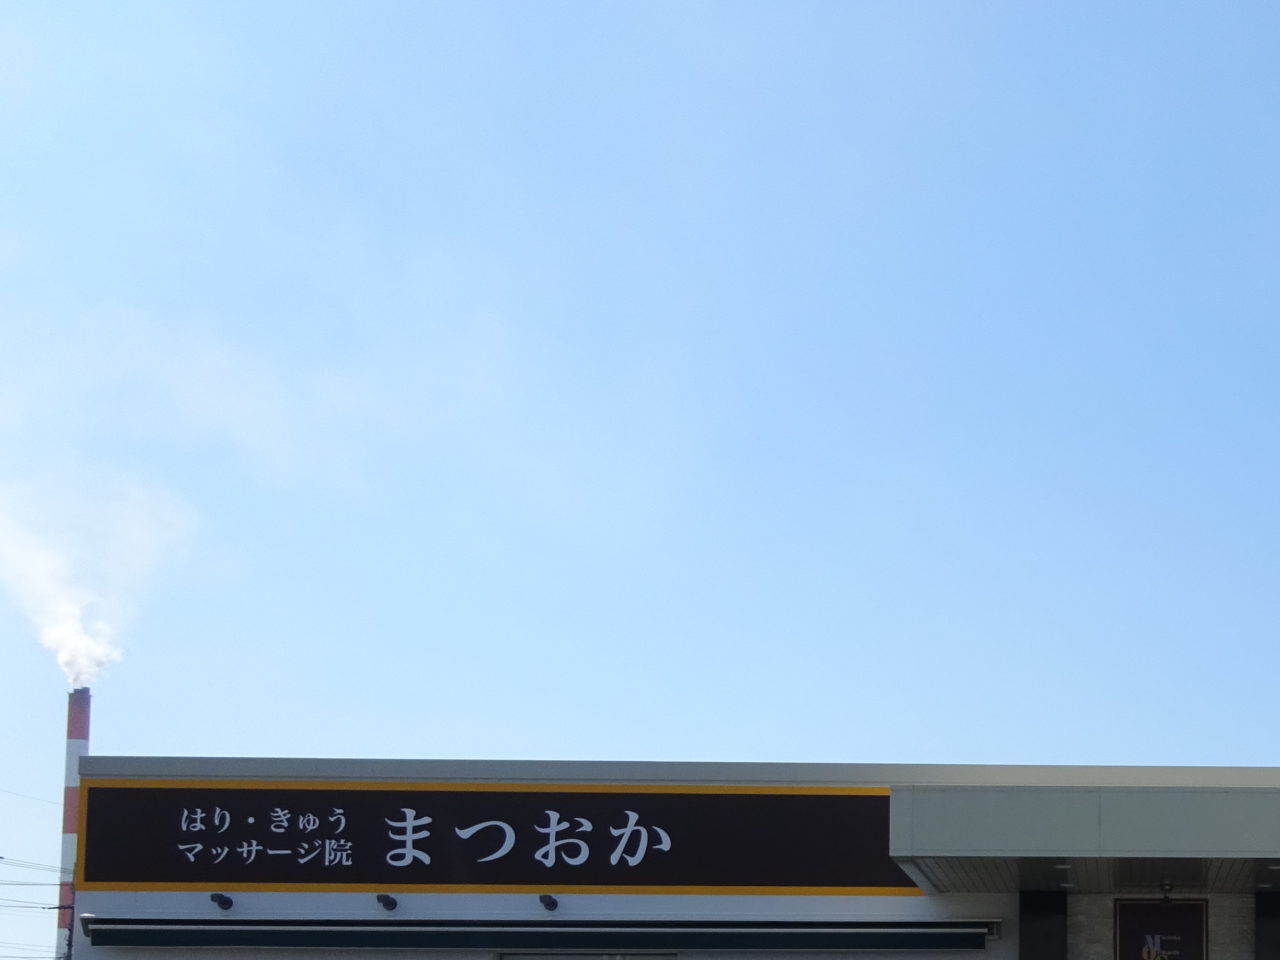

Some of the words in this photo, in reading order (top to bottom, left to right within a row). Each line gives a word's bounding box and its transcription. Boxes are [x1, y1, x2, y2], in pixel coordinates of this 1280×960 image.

[181, 806, 346, 834] はり・きゅう
[384, 807, 672, 868] まつおか
[177, 838, 353, 866] マッサージ院
